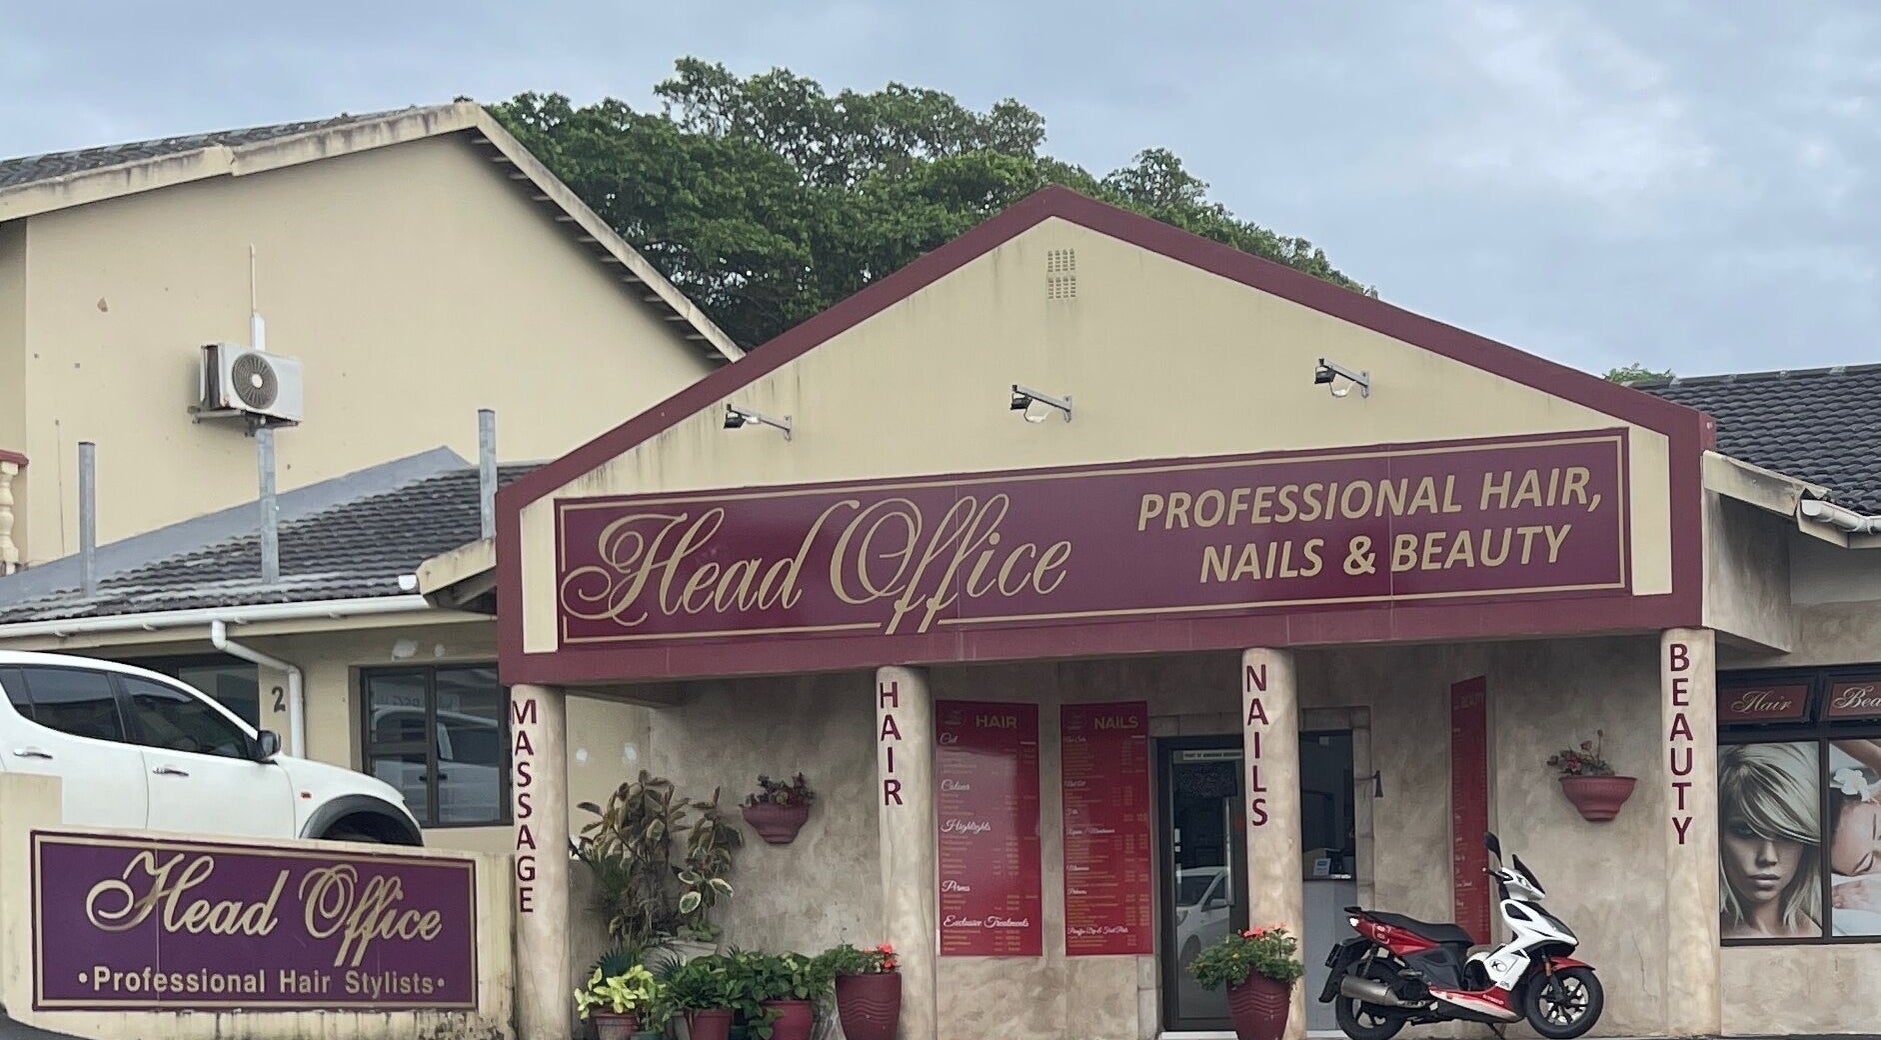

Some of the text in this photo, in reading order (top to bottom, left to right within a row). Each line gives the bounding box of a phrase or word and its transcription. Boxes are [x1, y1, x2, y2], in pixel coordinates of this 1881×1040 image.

[1137, 466, 1602, 531] PROFESSIONAL HAIR,
[561, 493, 1072, 636] Head Office
[1199, 523, 1572, 583] NAILS & BEAUTY
[271, 686, 286, 713] 2
[975, 715, 1017, 729] HAIR
[1094, 715, 1139, 730] NAILS
[1731, 690, 1793, 714] Hair
[880, 681, 903, 806] HAIR
[1246, 664, 1269, 827] NAILS
[1669, 643, 1694, 845] BEAUTY
[511, 699, 537, 913] MASSAGE
[940, 818, 991, 835] Highlights
[86, 851, 443, 968] Head Office
[983, 915, 1030, 929] Treatments
[93, 965, 434, 999] Professional Hair Stylists
